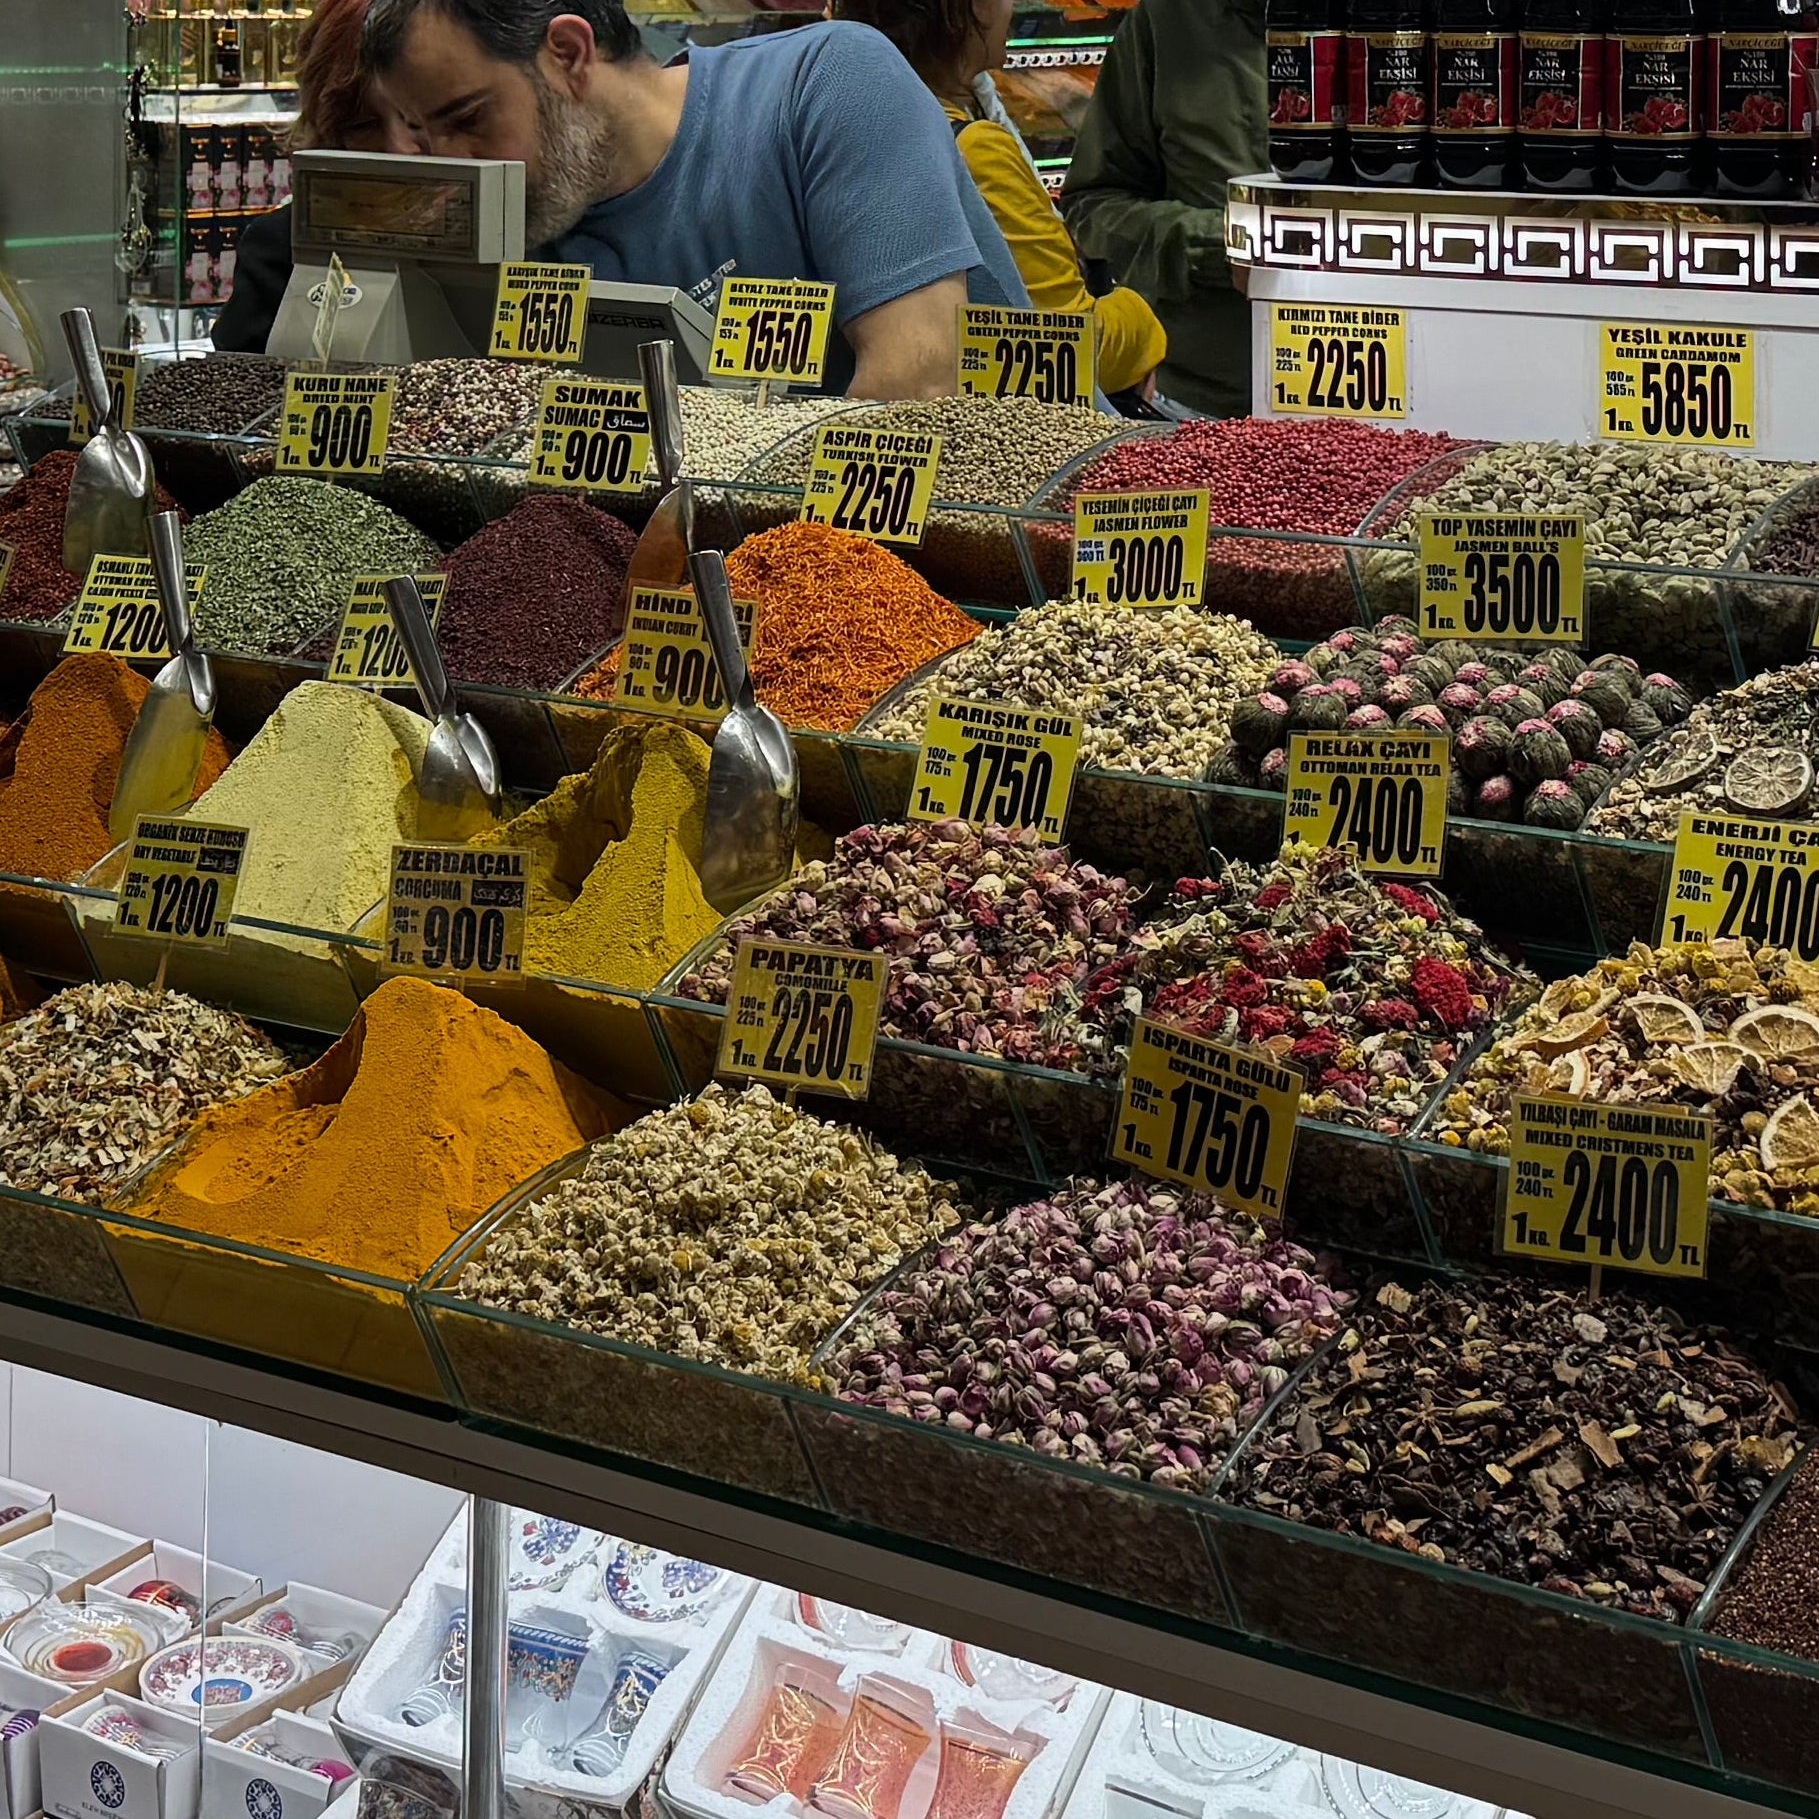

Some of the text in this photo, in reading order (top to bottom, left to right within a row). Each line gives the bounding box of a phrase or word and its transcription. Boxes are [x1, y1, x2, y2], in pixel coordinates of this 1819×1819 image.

[1642, 61, 1669, 73] NAR
[1733, 70, 1775, 84] EKŞİSİ
[1740, 58, 1768, 69] NAR
[518, 292, 573, 353] 1550
[965, 310, 1084, 328] YEŞİL TANE BİBER
[1328, 309, 1400, 326] TANE BİBER
[744, 310, 812, 374] 1550
[1608, 327, 1747, 348] YEŞİL KAKULE
[1661, 349, 1741, 363] CARDAMOM
[294, 377, 388, 392] KURU NANE
[995, 338, 1076, 405] 2250
[1307, 338, 1386, 411] 2250
[555, 385, 641, 408] SUMAK
[1642, 362, 1731, 440] 5850
[544, 406, 601, 428] SUMAC
[606, 414, 645, 428] سماق
[308, 405, 372, 468] 900
[823, 430, 933, 454] ASPİR ÇİÇEĞİ
[562, 430, 632, 484] 900
[823, 449, 875, 462] TURKISH
[831, 462, 915, 535] 2250
[1141, 515, 1188, 530] FLOWER
[1431, 516, 1577, 541] TOP YASEMİN ÇAYI
[1454, 540, 1559, 553] JASMEN BALL'S
[1107, 535, 1183, 603] 3000
[635, 593, 692, 616] HİND
[1464, 552, 1560, 634] 3500
[100, 602, 167, 653] 1200
[632, 617, 664, 633] INDIAN
[652, 645, 724, 710] 900
[938, 702, 1073, 737] KARIŞIK GÜL
[961, 726, 1042, 749] MIXED ROSE
[1306, 739, 1431, 761] RELAX ÇAYI
[1300, 760, 1441, 776] OTTOMAN RELAX TEA
[958, 742, 1053, 828] 1750
[1326, 775, 1423, 864] 2400
[1691, 818, 1781, 842] ENERJİ
[397, 850, 524, 879] ZERDAÇAL
[1716, 842, 1807, 866] ENERGY TEA
[147, 873, 219, 938] 1200
[422, 905, 504, 972] 900
[750, 948, 874, 981] PAPATYA
[775, 973, 848, 993] COMOMILLE
[762, 987, 853, 1080] 2250
[1143, 1025, 1291, 1093] ISPARTA GÜLÜ
[1168, 1056, 1259, 1101] ISPARTA ROSE
[1520, 1102, 1706, 1140] YILBAŞI ÇAYI GARAM MASALA
[1166, 1080, 1271, 1200] 1750
[1525, 1129, 1695, 1162] MIXED CRISTMENS TEA
[1516, 1179, 1541, 1197] 240
[1559, 1150, 1679, 1265] 2400
